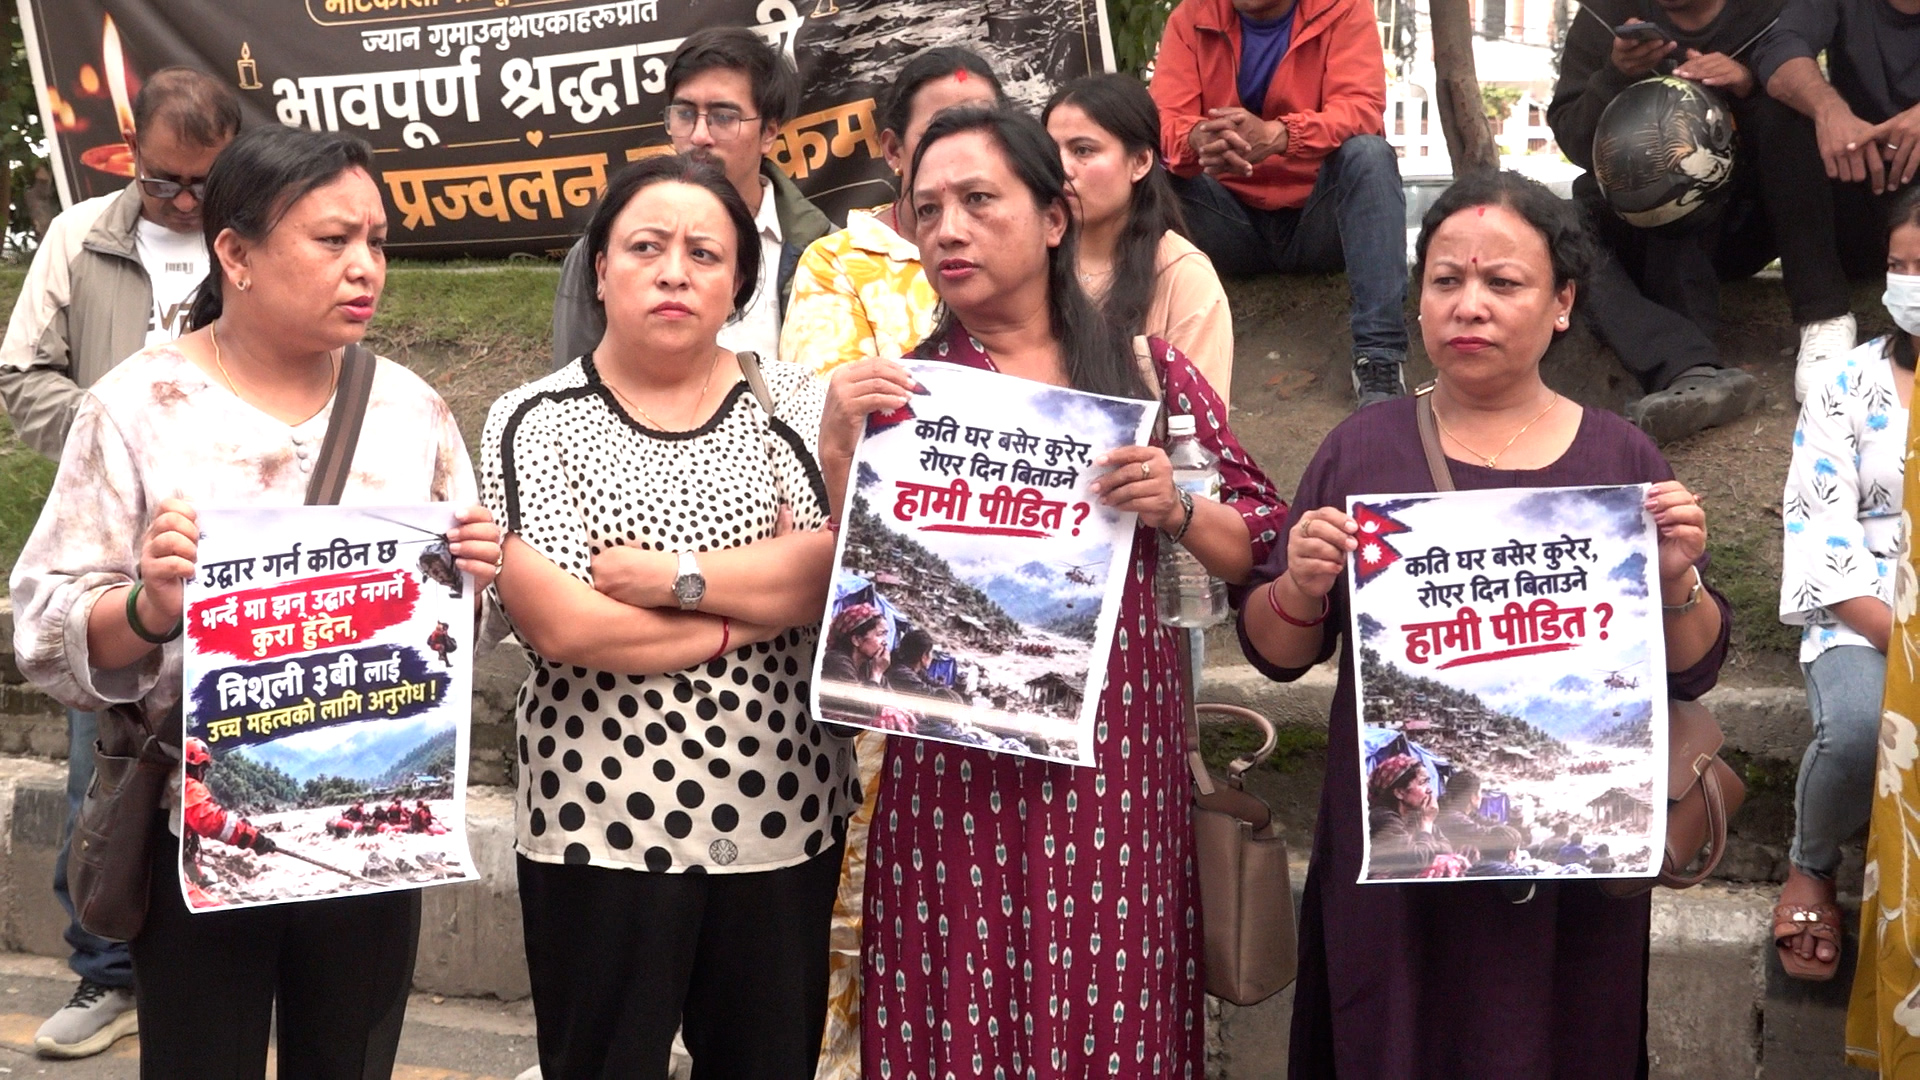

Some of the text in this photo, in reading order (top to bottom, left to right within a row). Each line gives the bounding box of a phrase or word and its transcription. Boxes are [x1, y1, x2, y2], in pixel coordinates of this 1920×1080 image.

[361, 26, 421, 52] ज्यान
[272, 45, 481, 149] भावपूर्ण
[915, 415, 959, 444] कति
[964, 425, 994, 450] घर
[998, 428, 1041, 457] बसेर
[920, 445, 1078, 490] रोएर दिन बिताउने
[893, 478, 972, 522] हामी
[979, 485, 1067, 530] पीडित
[263, 543, 302, 577] गर्न
[307, 537, 371, 572] कठिन
[377, 540, 398, 564] छ
[1405, 546, 1451, 578] कति
[1456, 548, 1486, 571] घर
[1491, 538, 1537, 573] बसेर
[244, 598, 267, 620] मा
[1417, 565, 1588, 609] रोएर दिन बिताउने
[251, 623, 295, 657] कुरा
[1401, 606, 1482, 665] हामी
[1490, 598, 1587, 646] पीडित
[217, 661, 304, 711] त्रिशूली
[363, 650, 402, 685] लाई
[207, 716, 242, 742] उच्च
[320, 690, 363, 720] लागि
[368, 680, 426, 715] अनुरोध
